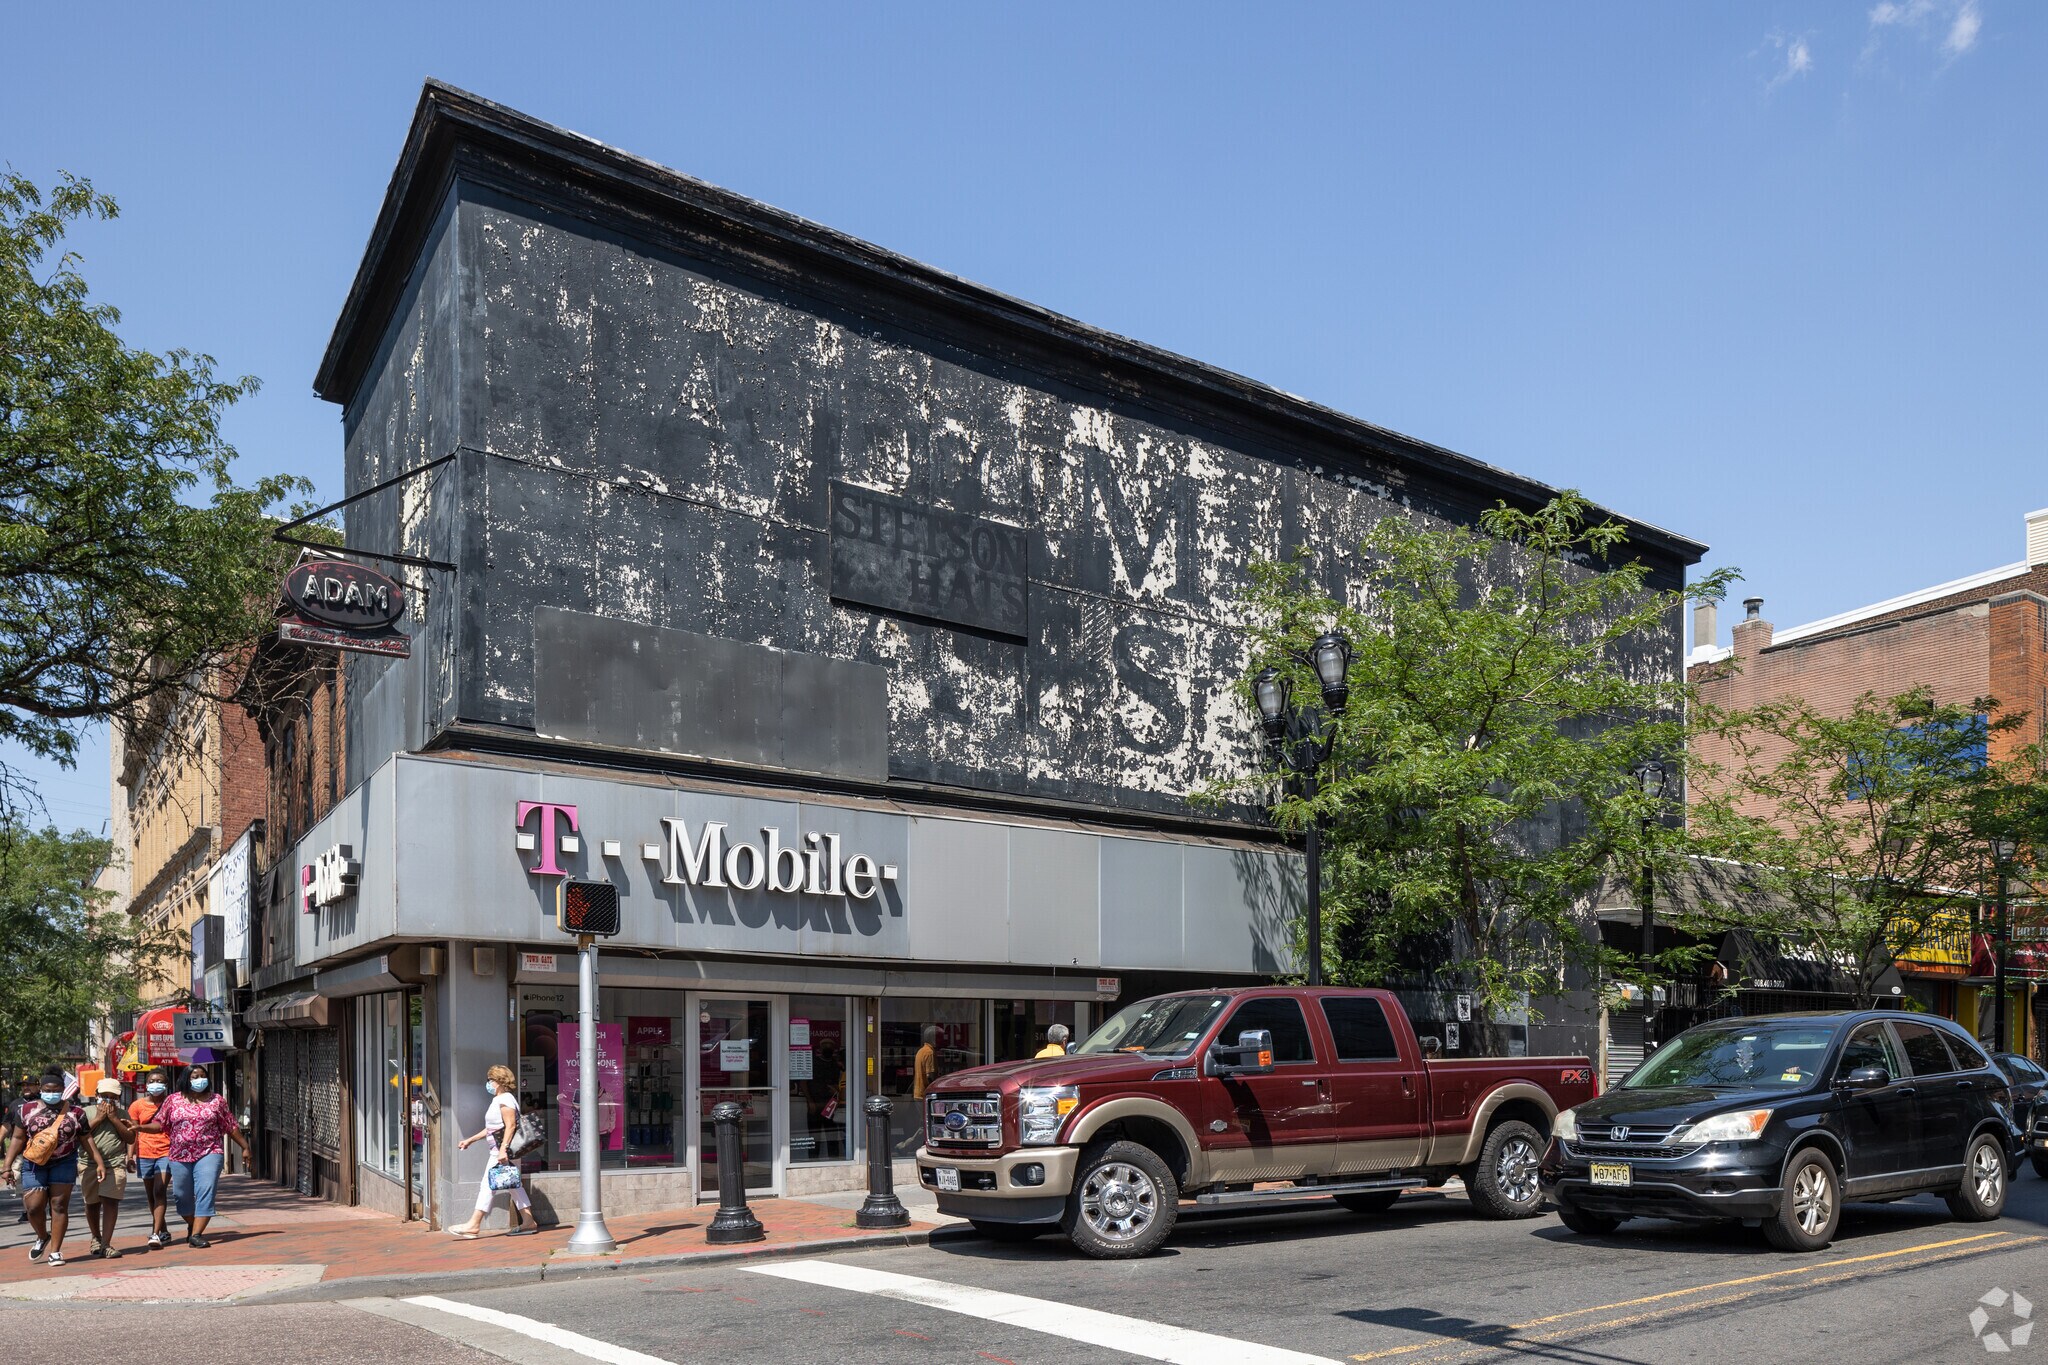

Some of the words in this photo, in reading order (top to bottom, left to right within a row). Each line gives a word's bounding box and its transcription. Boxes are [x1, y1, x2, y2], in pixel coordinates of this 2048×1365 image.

[835, 497, 1026, 578] STETSON
[302, 574, 388, 610] ADAM
[907, 558, 1025, 625] HATS
[529, 993, 555, 1002] iPhone
[184, 1017, 198, 1026] WE
[183, 1031, 224, 1041] GOLD
[636, 1026, 664, 1036] APPLE
[1561, 1069, 1590, 1081] FX4
[1093, 1237, 1135, 1249] COOPER
